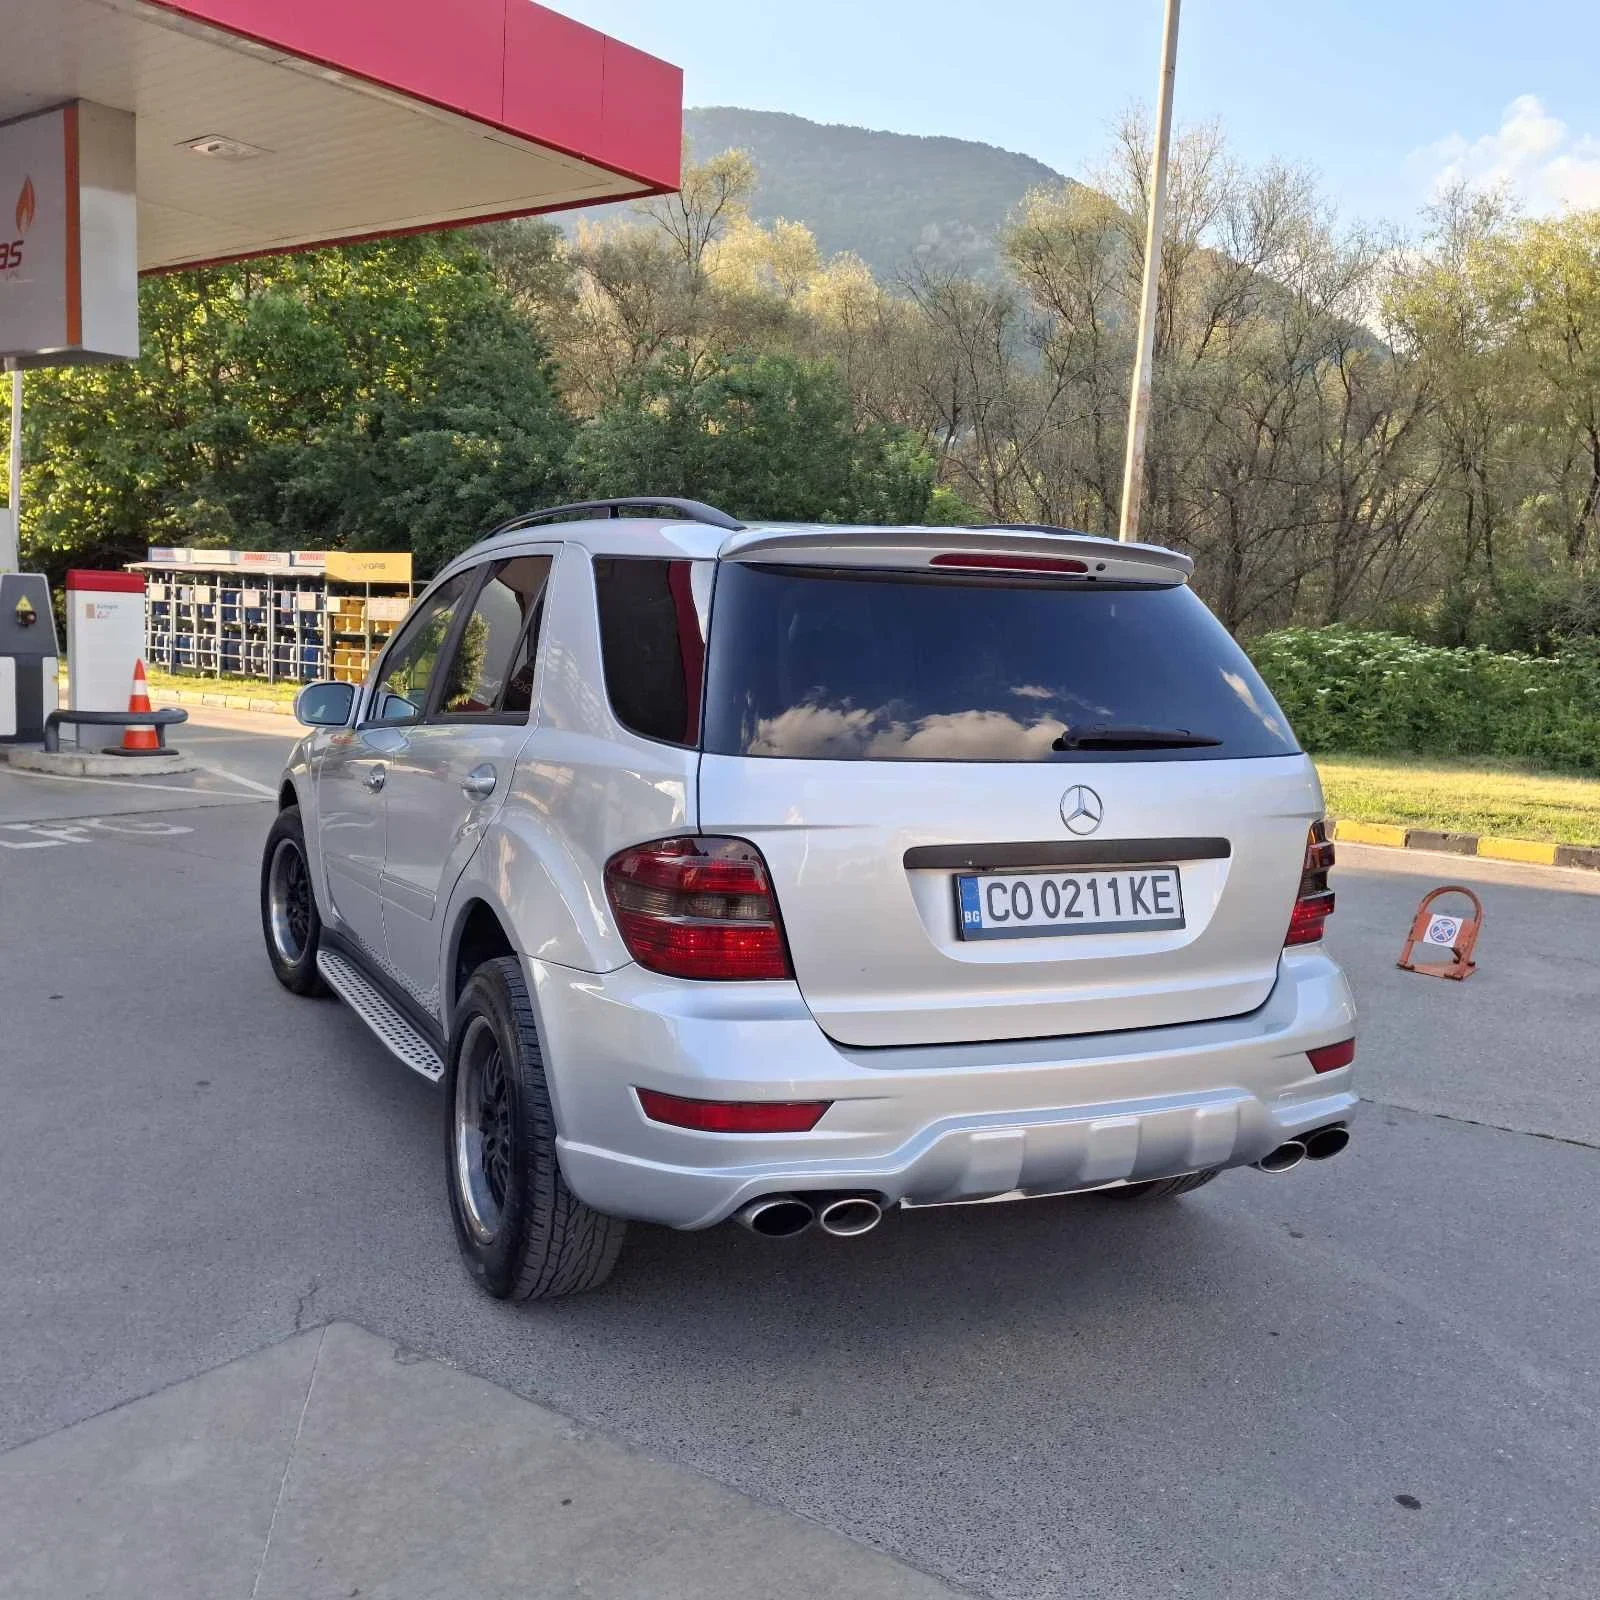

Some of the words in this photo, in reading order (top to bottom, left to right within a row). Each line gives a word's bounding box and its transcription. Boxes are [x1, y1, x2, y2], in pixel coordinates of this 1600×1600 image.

[1040, 877, 1121, 919] 0211
[1129, 875, 1174, 915] KE
[964, 910, 980, 923] BG
